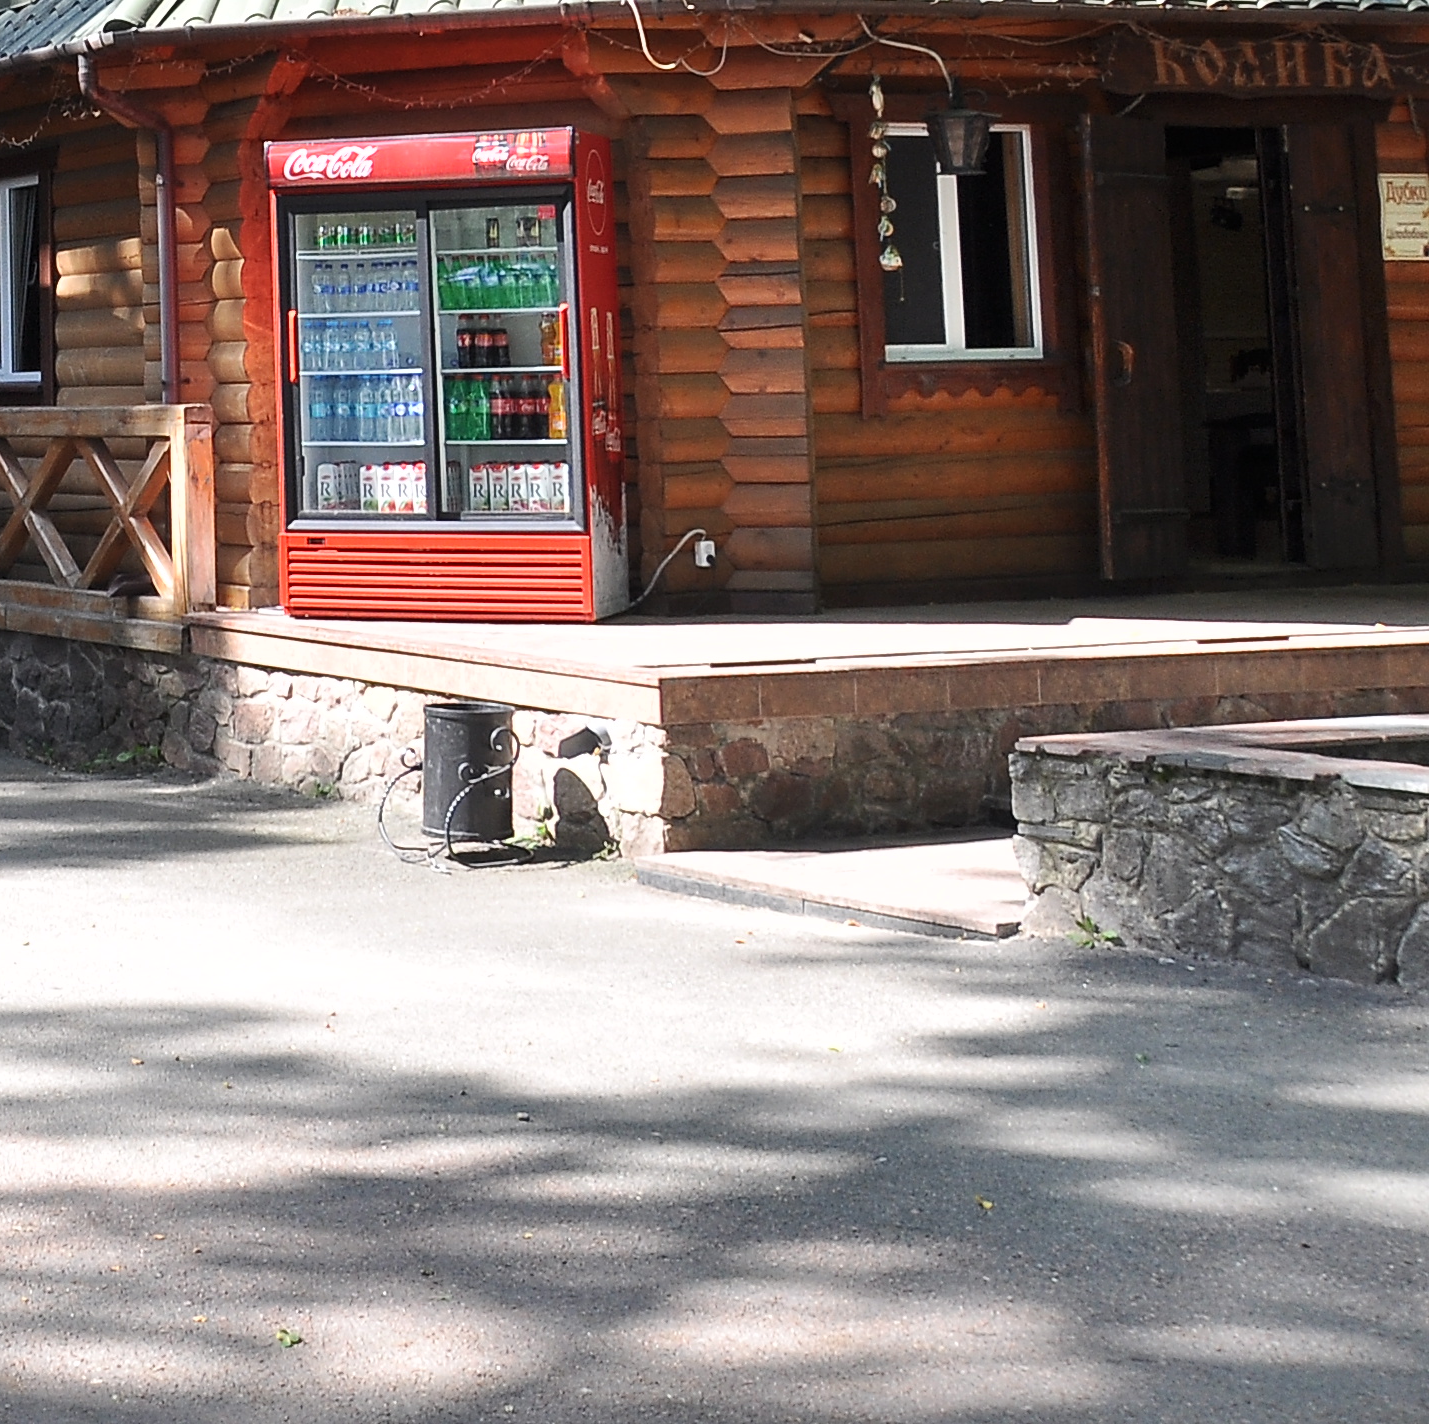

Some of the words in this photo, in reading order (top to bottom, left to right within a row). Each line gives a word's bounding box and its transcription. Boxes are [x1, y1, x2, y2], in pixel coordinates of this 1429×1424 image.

[283, 145, 378, 181] Coca-Cola
[320, 481, 331, 496] R
[363, 483, 374, 497] R
[381, 483, 392, 497] R
[398, 483, 409, 497] R
[415, 483, 427, 497] R
[473, 483, 485, 498] R
[493, 483, 504, 498] R
[511, 483, 522, 498] R
[530, 483, 541, 497] R
[552, 482, 564, 496] R
